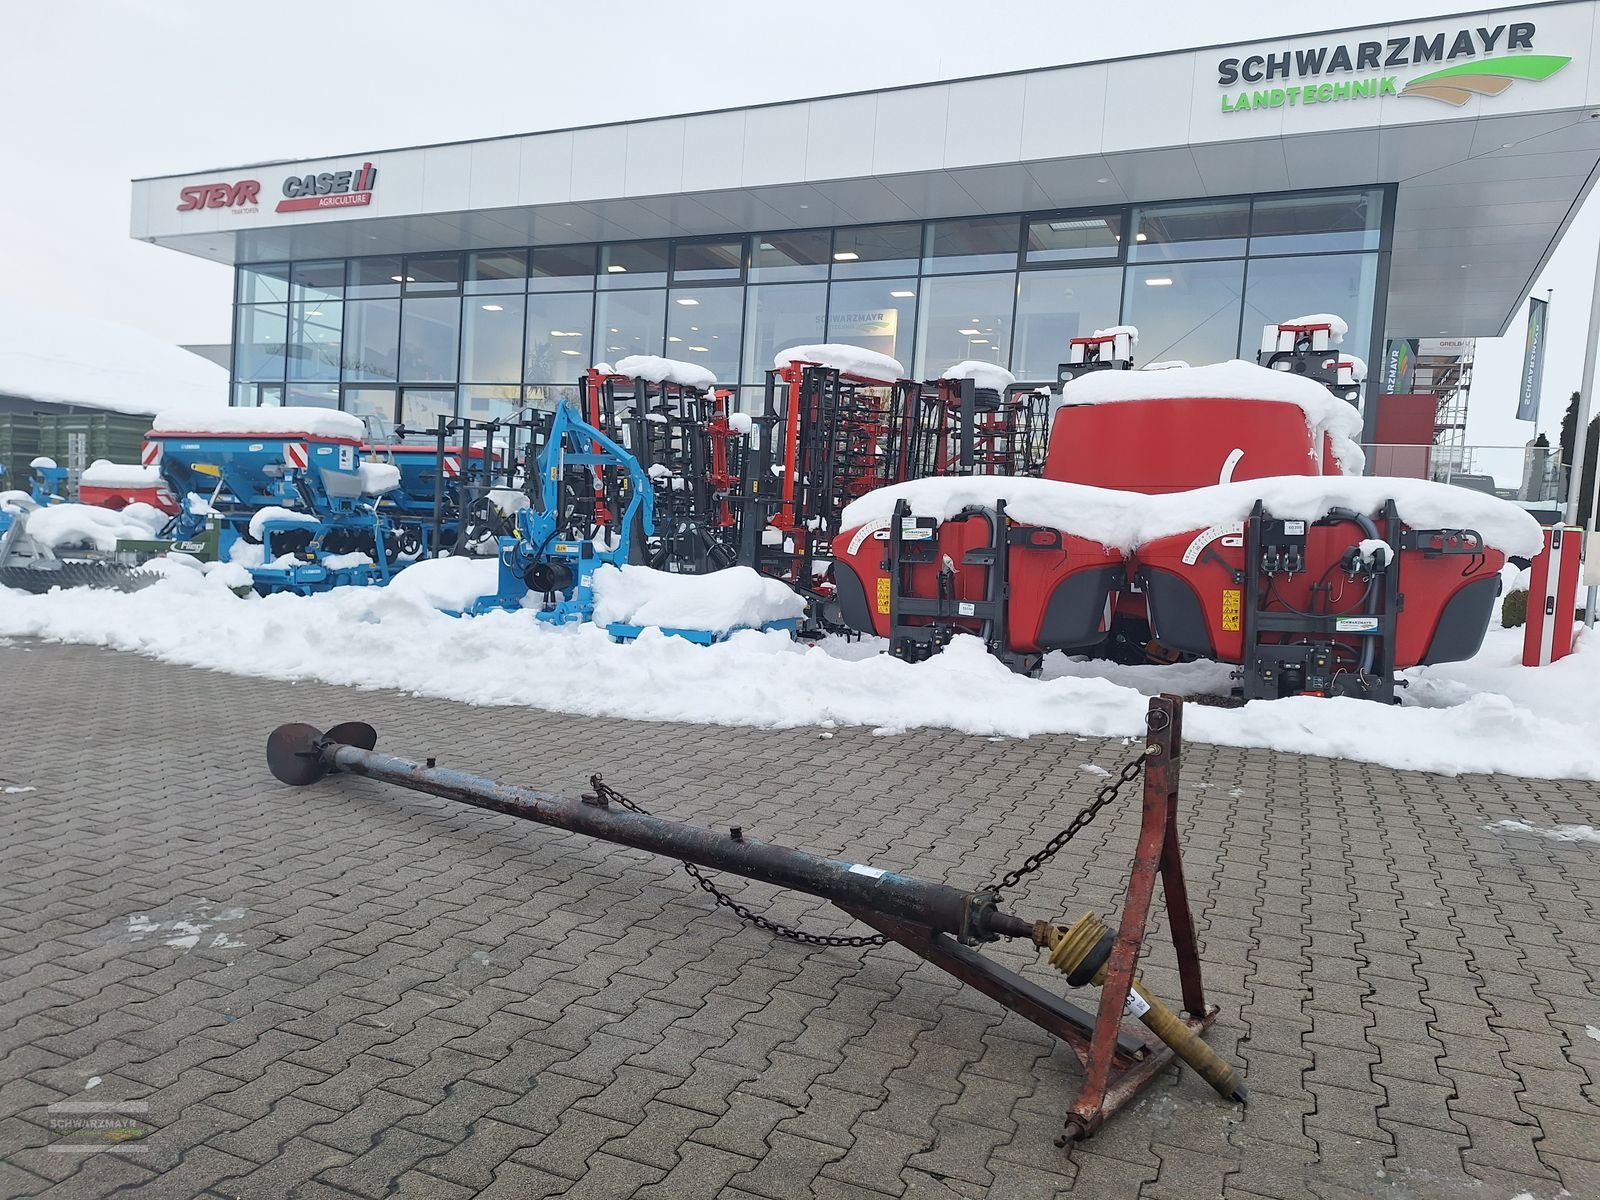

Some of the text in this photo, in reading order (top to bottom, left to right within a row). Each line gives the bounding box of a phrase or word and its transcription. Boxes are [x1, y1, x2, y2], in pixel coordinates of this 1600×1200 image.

[1217, 22, 1536, 85] SCHWARZMAYR
[1221, 76, 1397, 113] LANDTECHNIK
[176, 180, 261, 212] STEYR
[282, 171, 352, 198] CASE
[318, 194, 366, 207] AGRICULTURE
[180, 541, 206, 551] Fliegl
